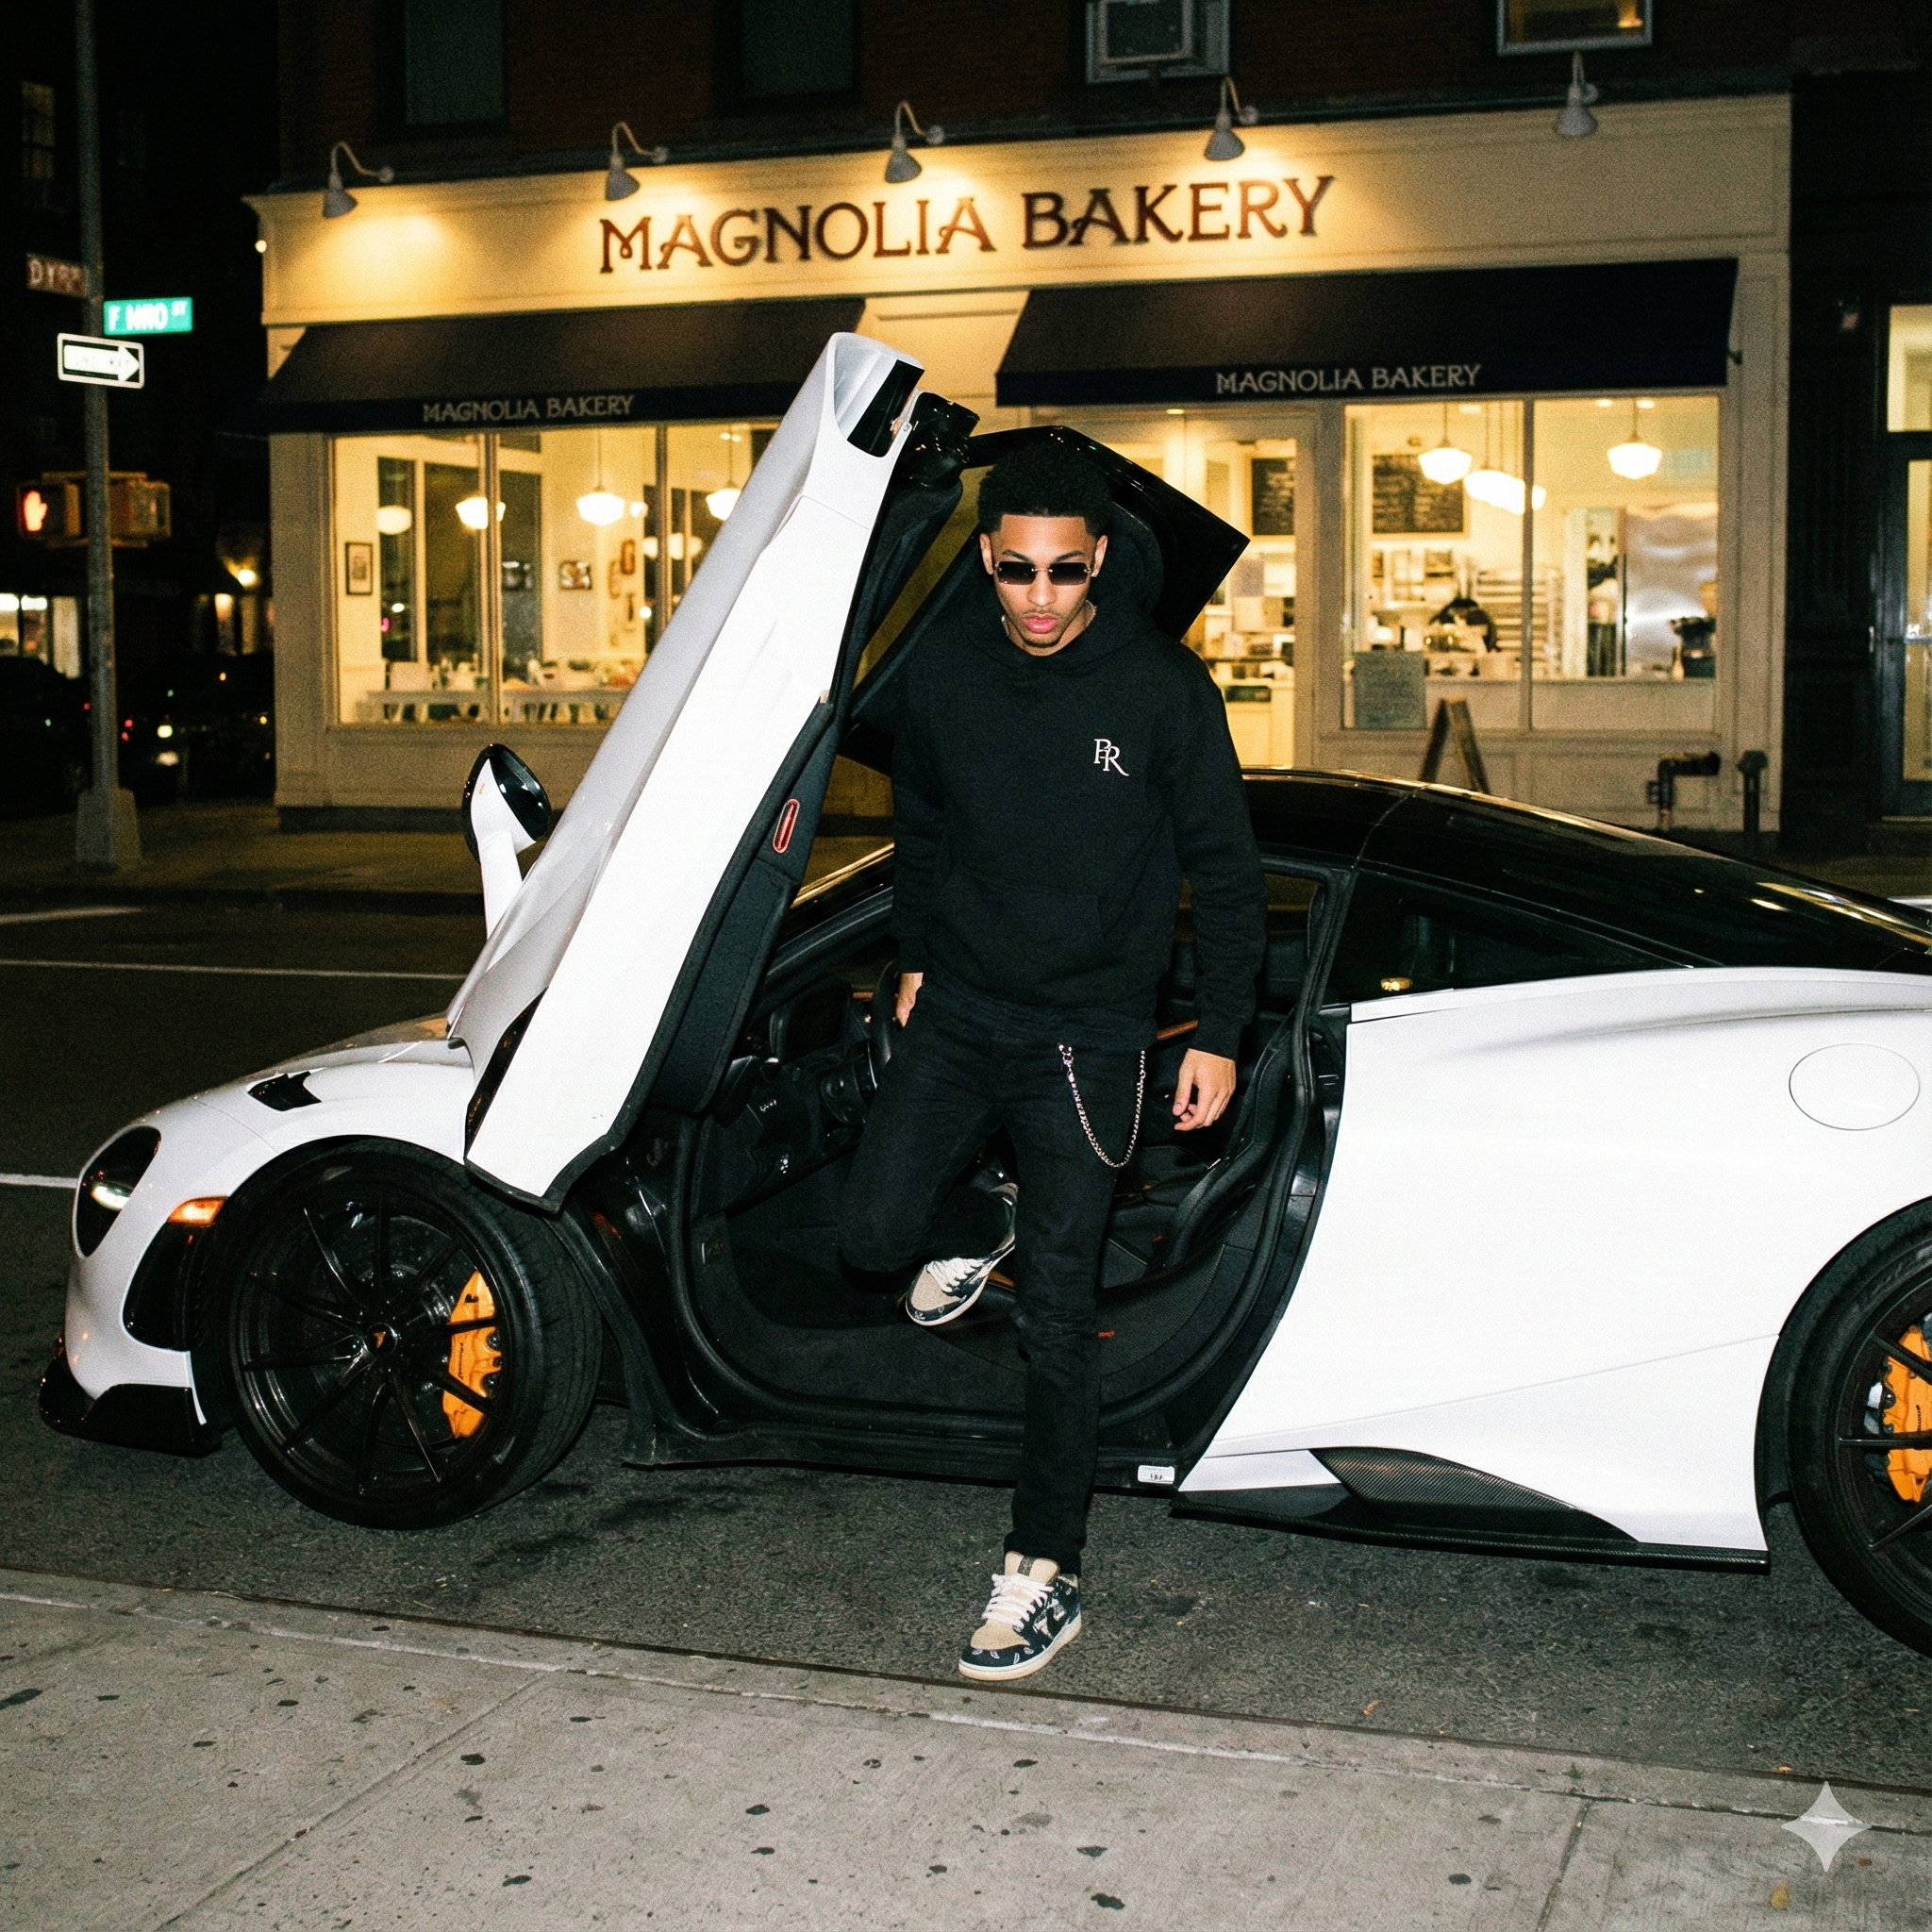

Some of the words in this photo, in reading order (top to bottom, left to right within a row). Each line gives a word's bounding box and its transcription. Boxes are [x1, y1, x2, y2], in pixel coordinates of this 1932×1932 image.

[598, 195, 998, 275] MAGNOLIA
[1021, 175, 1336, 252] BAKERY
[1216, 367, 1365, 395] MAGNOLIA
[1371, 363, 1482, 390] BAKERY
[424, 398, 541, 424] MAGNOLIA
[546, 393, 635, 418] BAKERY
